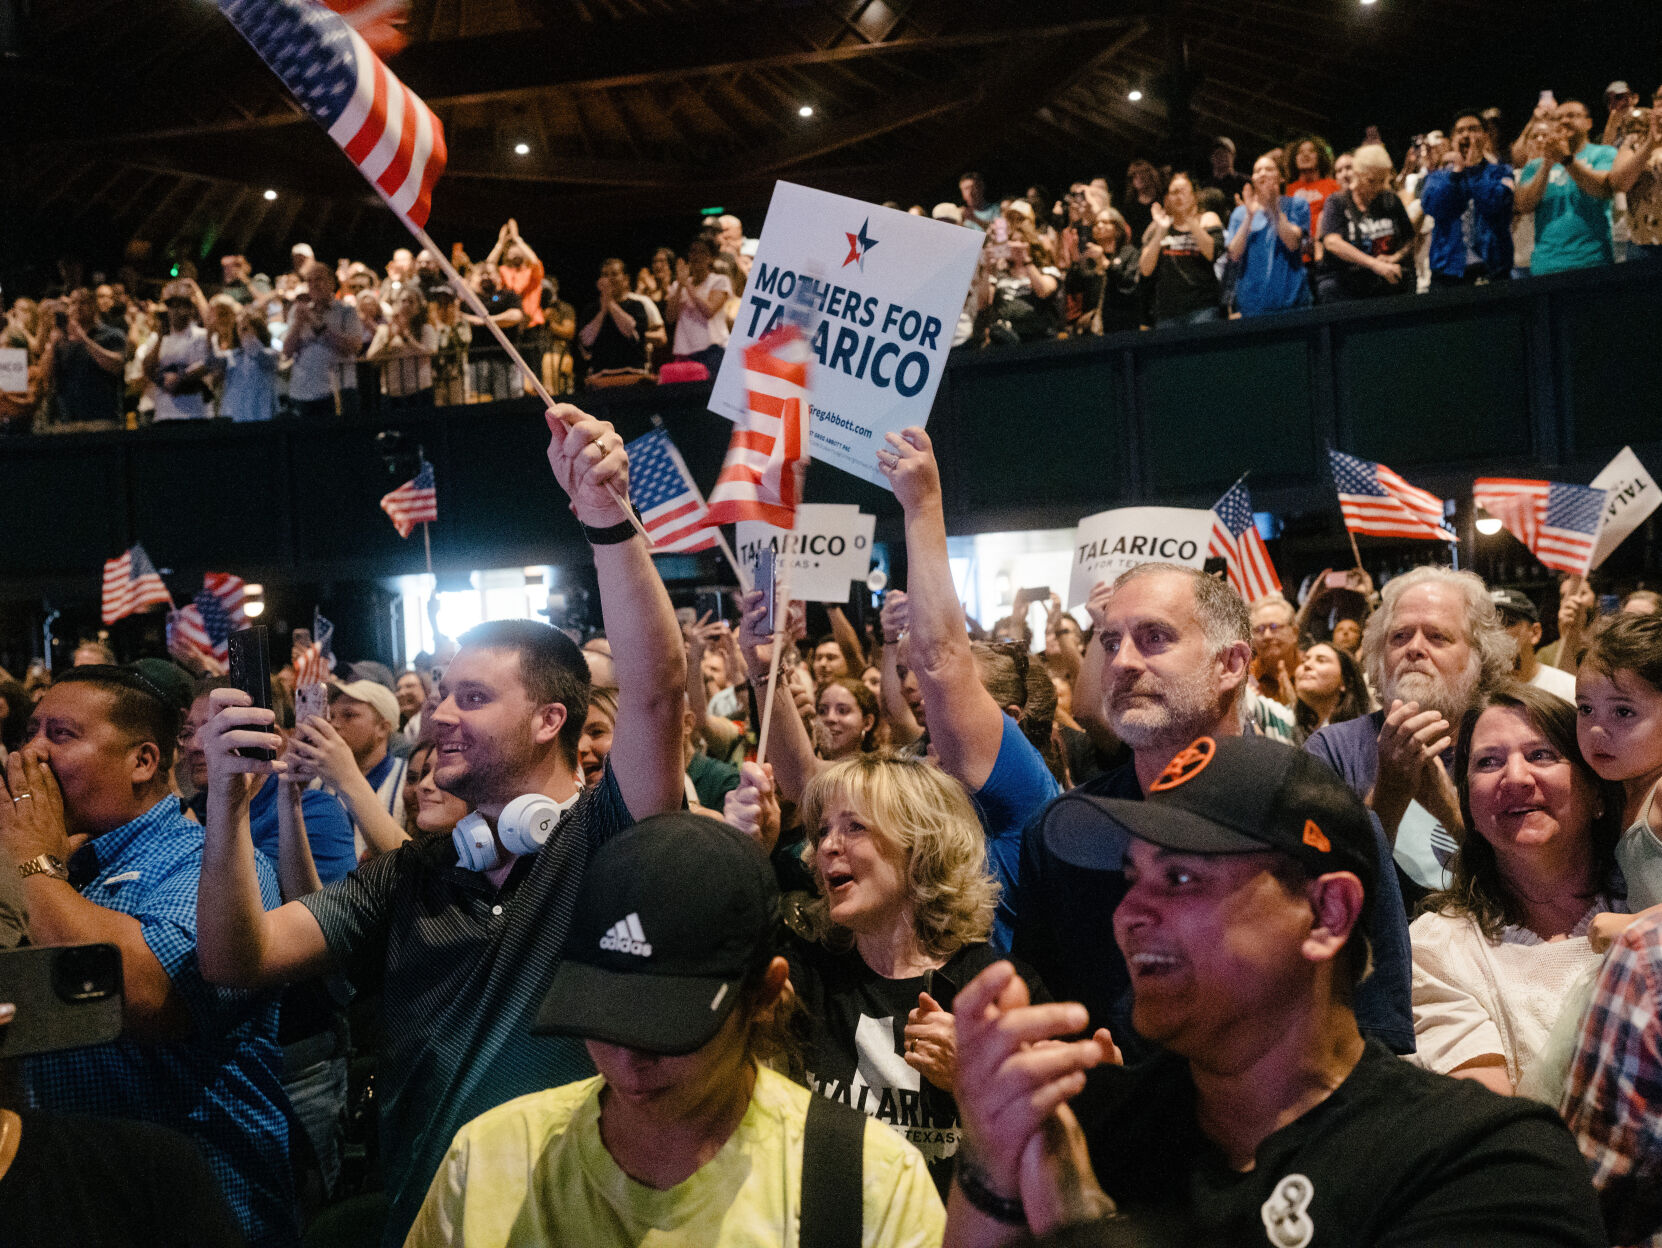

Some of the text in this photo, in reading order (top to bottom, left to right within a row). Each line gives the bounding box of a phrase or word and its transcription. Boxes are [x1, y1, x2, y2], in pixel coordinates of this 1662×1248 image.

[754, 262, 942, 350] MOTHERS FOR
[747, 295, 930, 398] TAARICO
[1079, 536, 1197, 564] TALARICO
[906, 1129, 955, 1144] TEXAS
